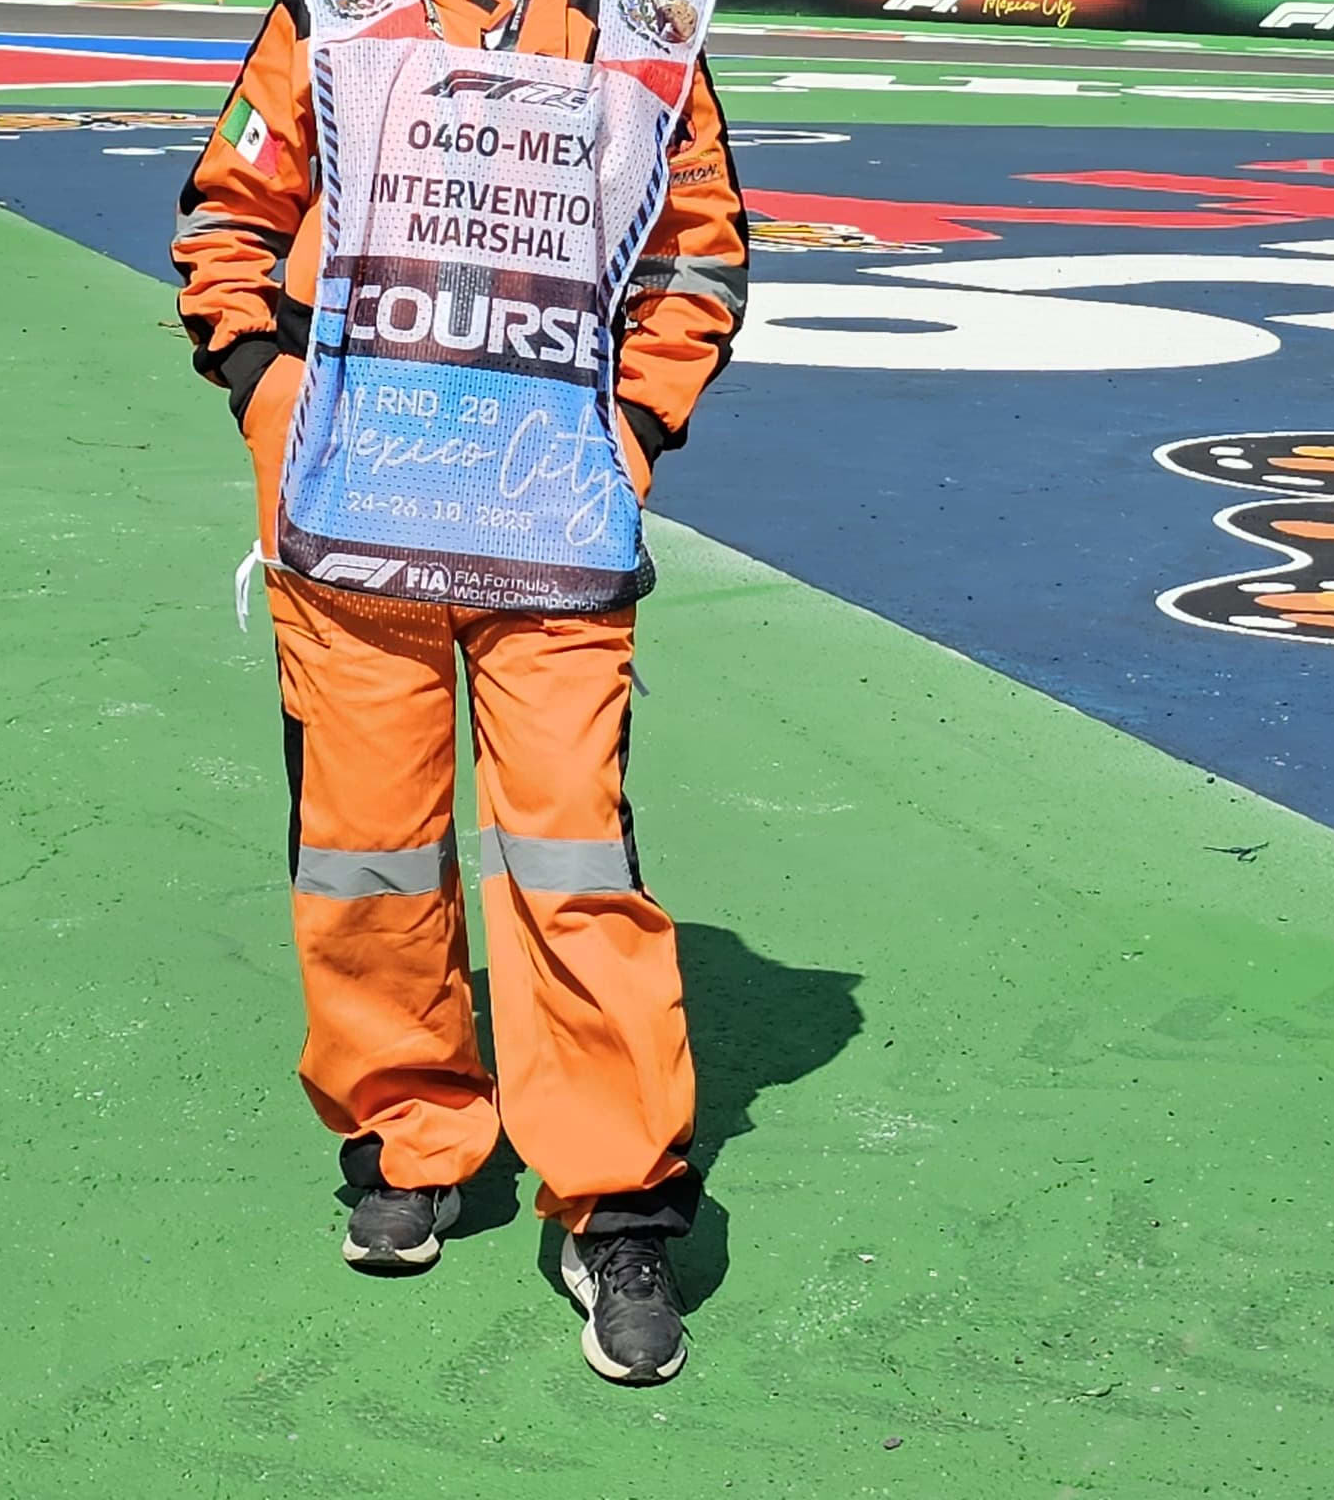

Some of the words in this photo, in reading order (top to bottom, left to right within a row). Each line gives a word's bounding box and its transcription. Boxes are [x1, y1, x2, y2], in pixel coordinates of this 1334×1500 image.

[420, 69, 536, 101] F1
[407, 119, 596, 171] 0460-MEX
[369, 172, 597, 229] INTERVENTIO
[406, 211, 572, 263] MARSHAL
[350, 284, 601, 370] COURSE
[321, 386, 499, 485] Mexico
[499, 400, 618, 547] City
[308, 552, 408, 589] F1
[405, 564, 450, 593] FIA
[453, 570, 480, 586] FIA
[485, 574, 549, 593] Formula
[452, 584, 501, 602] World
